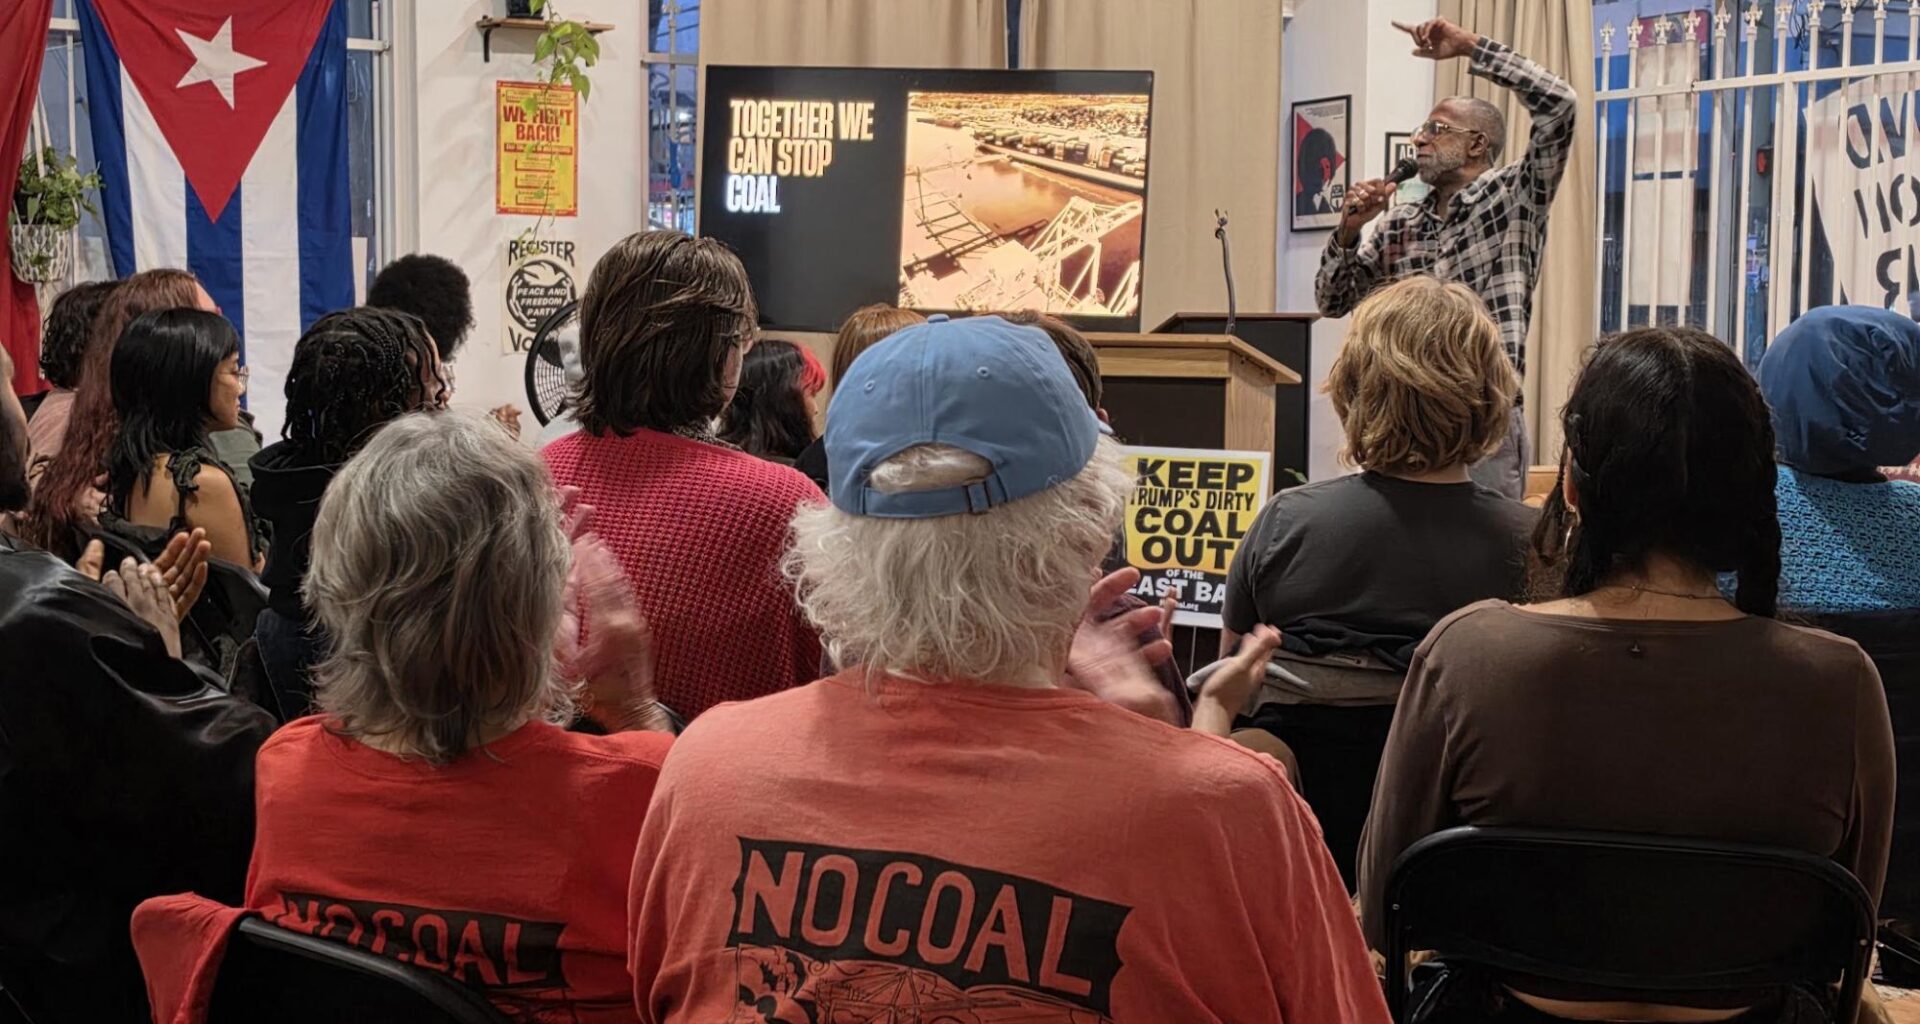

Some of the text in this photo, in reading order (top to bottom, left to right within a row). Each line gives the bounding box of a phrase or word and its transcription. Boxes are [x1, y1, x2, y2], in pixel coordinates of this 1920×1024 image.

[503, 105, 572, 126] WE FIGHT
[730, 100, 875, 140] TOGETHER WE
[516, 124, 560, 142] BACK!
[729, 137, 833, 177] CAN STOP
[727, 174, 781, 213] COAL
[508, 240, 575, 267] REGISTER
[518, 288, 567, 296] PEACE AND
[520, 298, 563, 306] FREEDOM
[527, 307, 558, 316] PARTY
[1136, 458, 1255, 490] KEEP
[1205, 490, 1256, 512] DIRTY
[1134, 507, 1248, 539] COAL
[1141, 536, 1235, 569] OUT
[1165, 568, 1205, 580] OF THE
[1194, 581, 1227, 604] BA
[738, 849, 1092, 997] NO COAL
